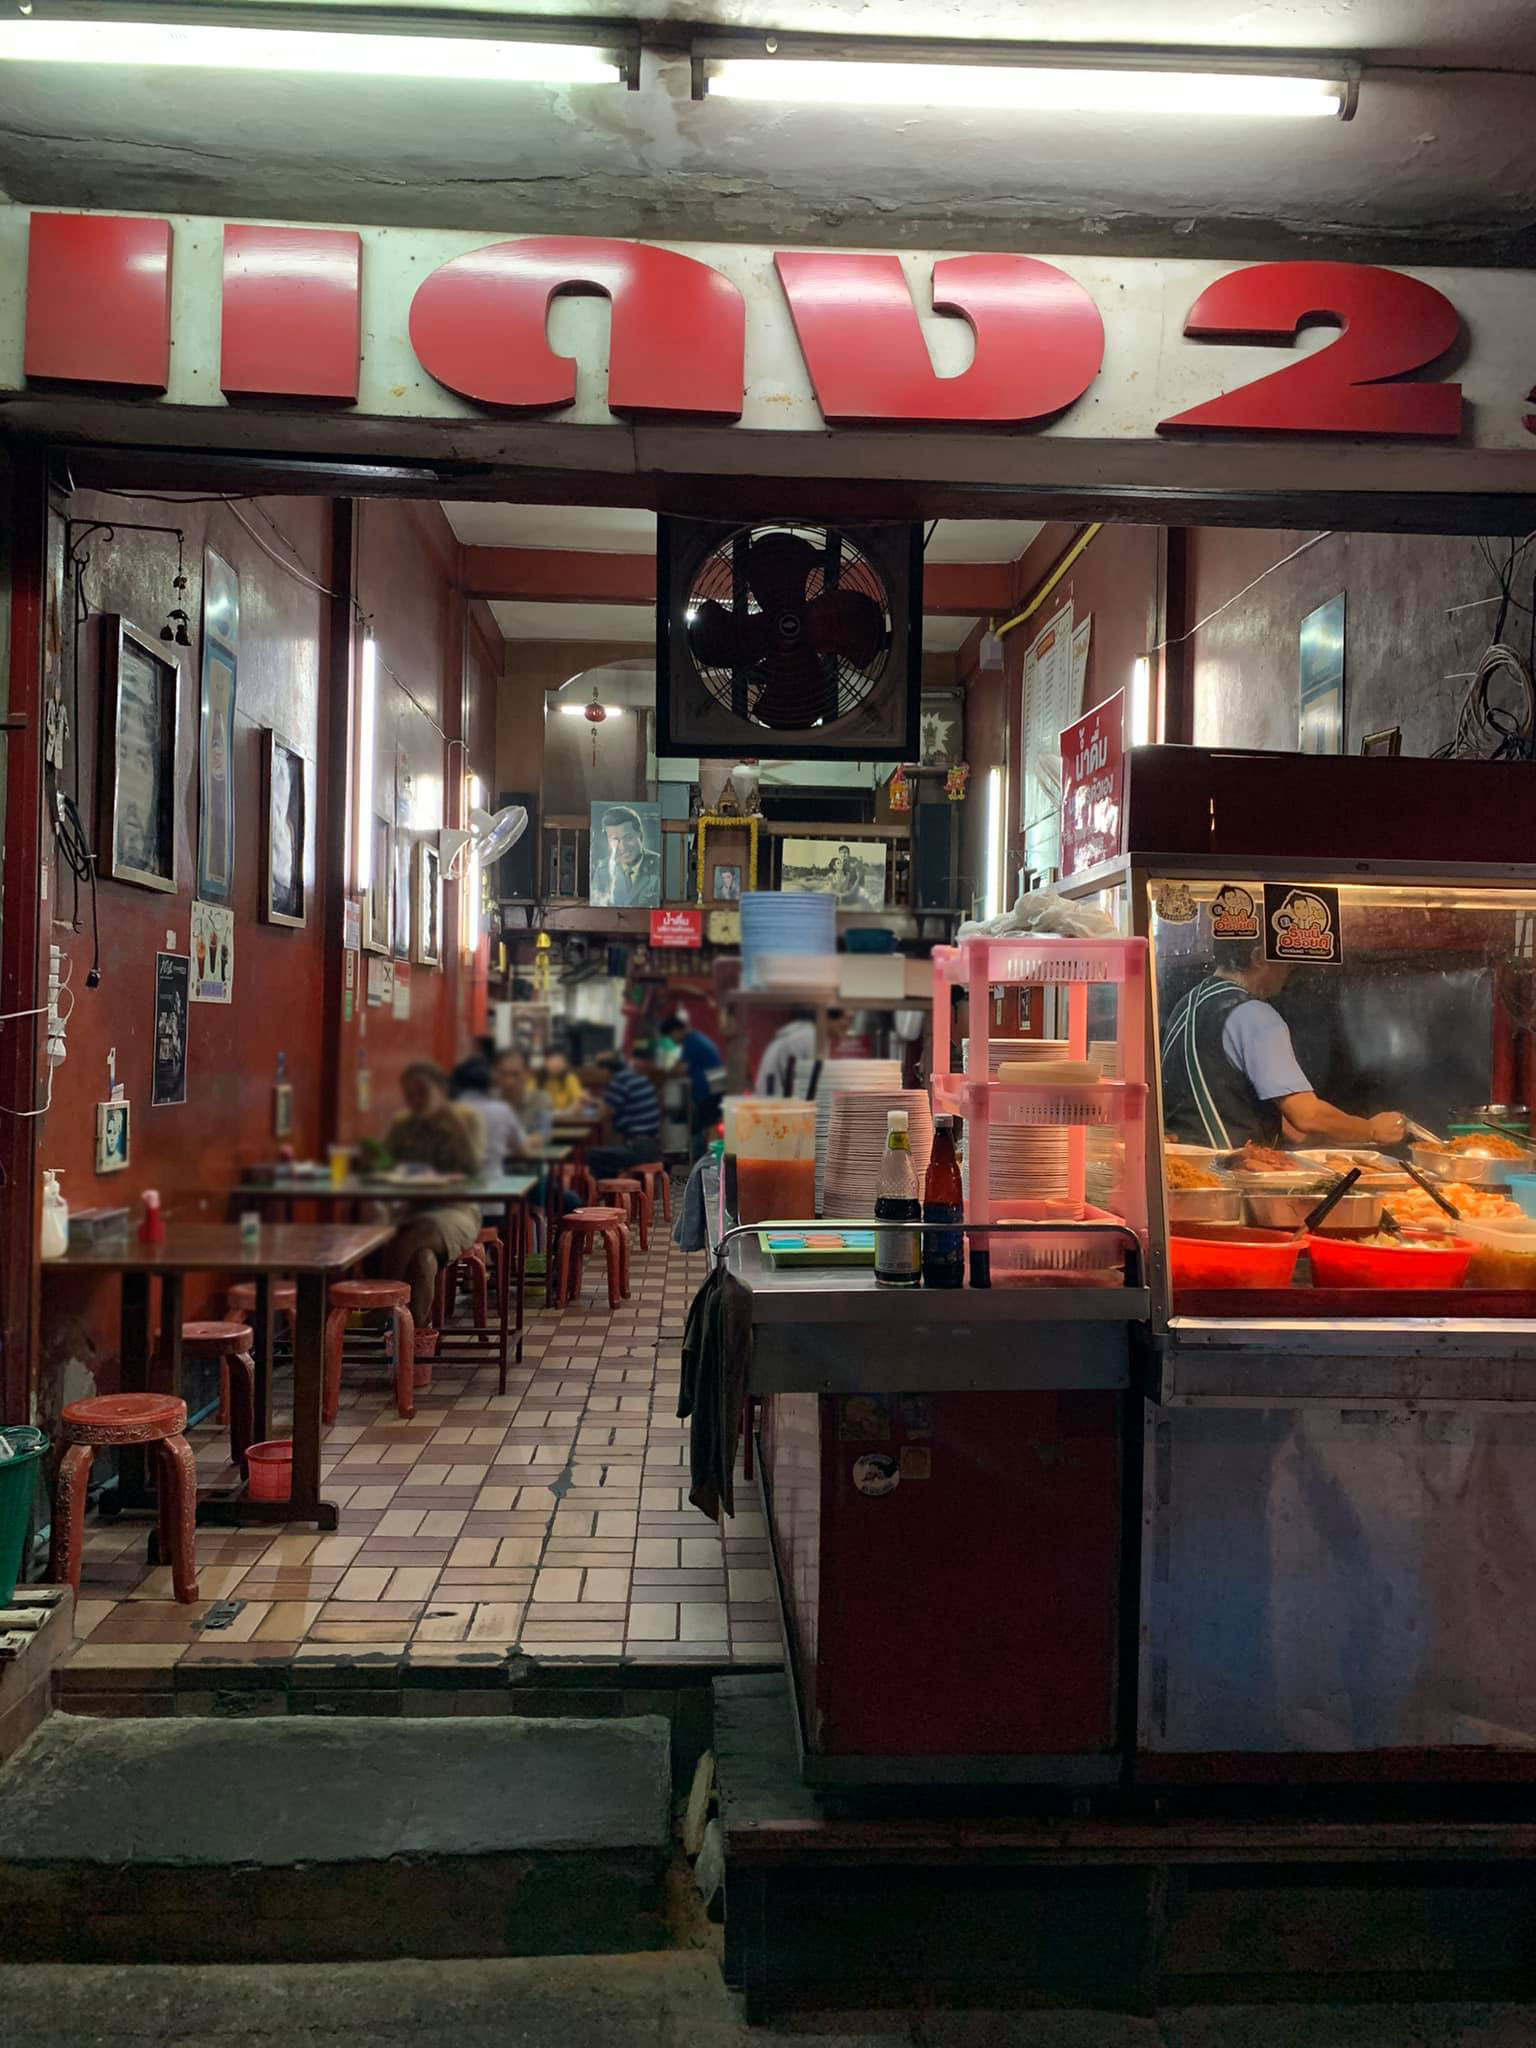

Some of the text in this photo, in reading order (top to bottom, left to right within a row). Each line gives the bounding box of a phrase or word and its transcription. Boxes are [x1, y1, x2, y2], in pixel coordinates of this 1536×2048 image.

[1157, 260, 1464, 437] 2
[1075, 717, 1108, 779] น้ำดื่ม
